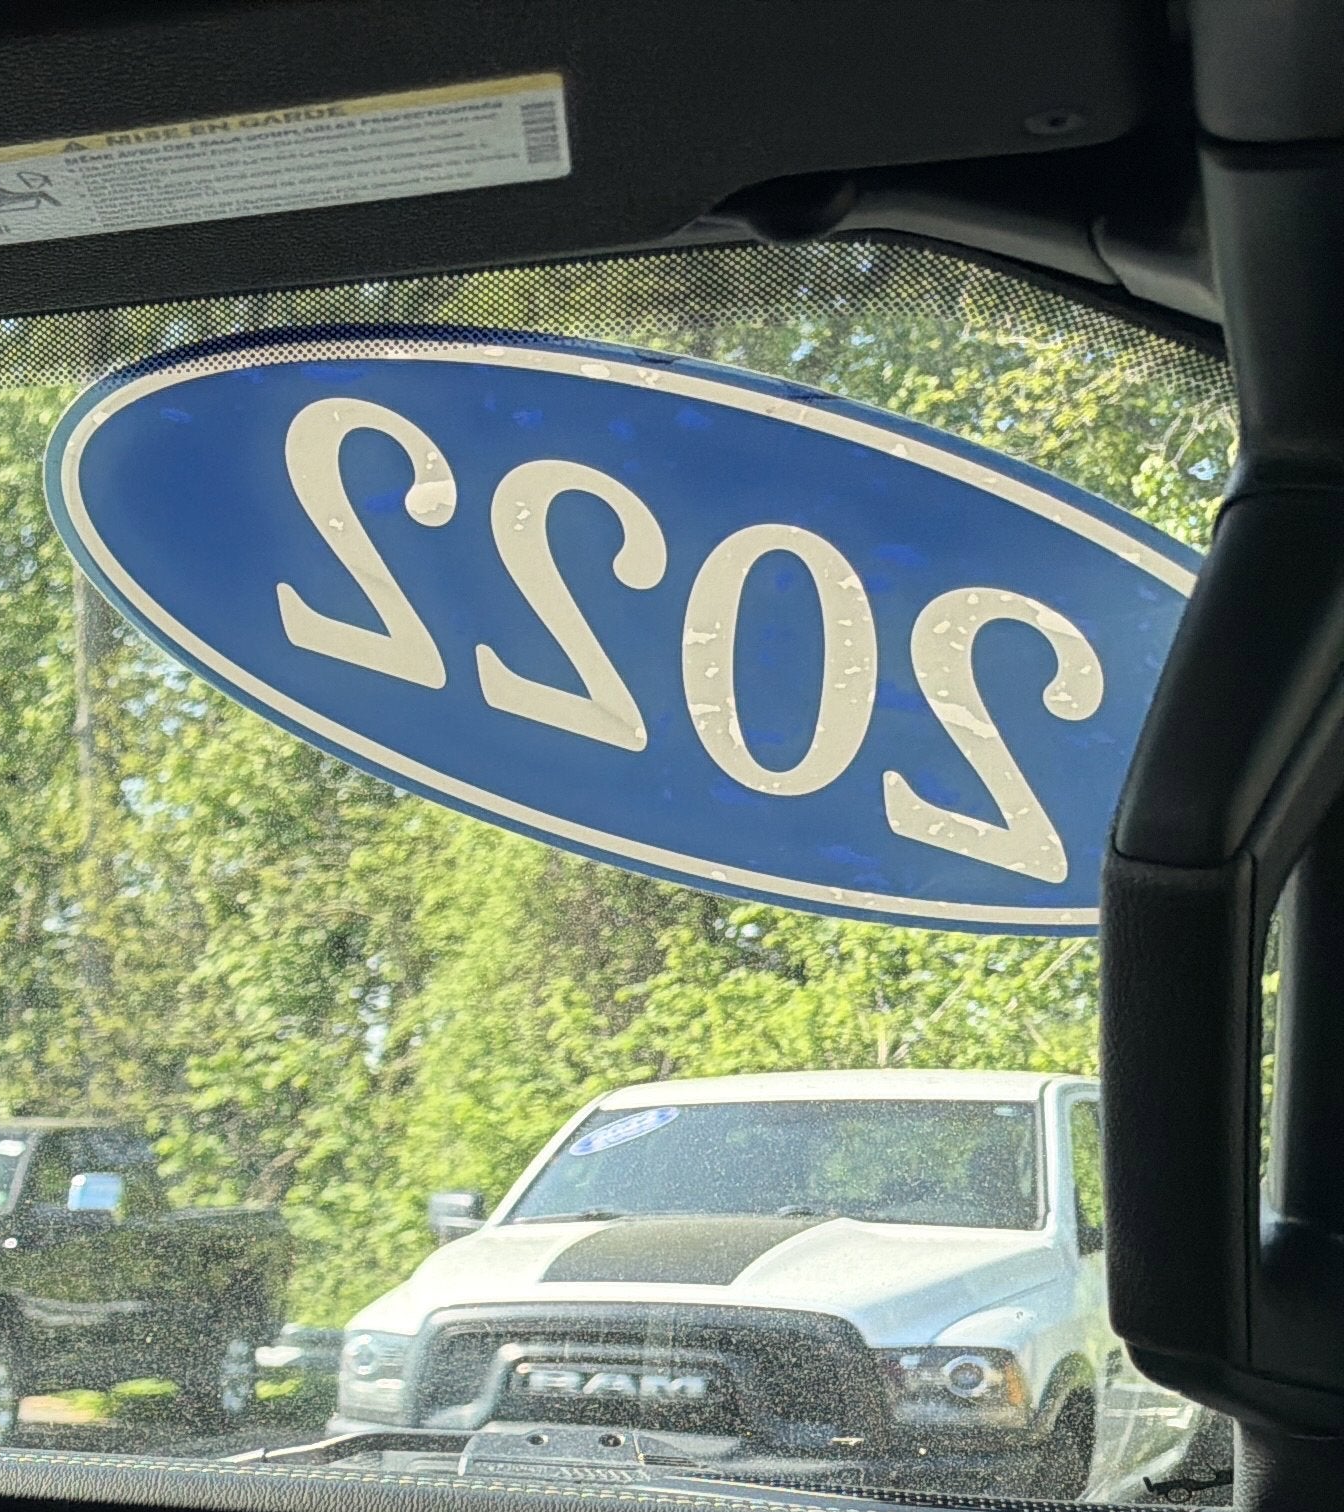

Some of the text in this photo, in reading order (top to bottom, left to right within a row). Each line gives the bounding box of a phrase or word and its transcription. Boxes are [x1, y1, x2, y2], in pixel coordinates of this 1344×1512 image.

[105, 105, 345, 146] MISE EN GARDE
[529, 1369, 706, 1398] RAM
